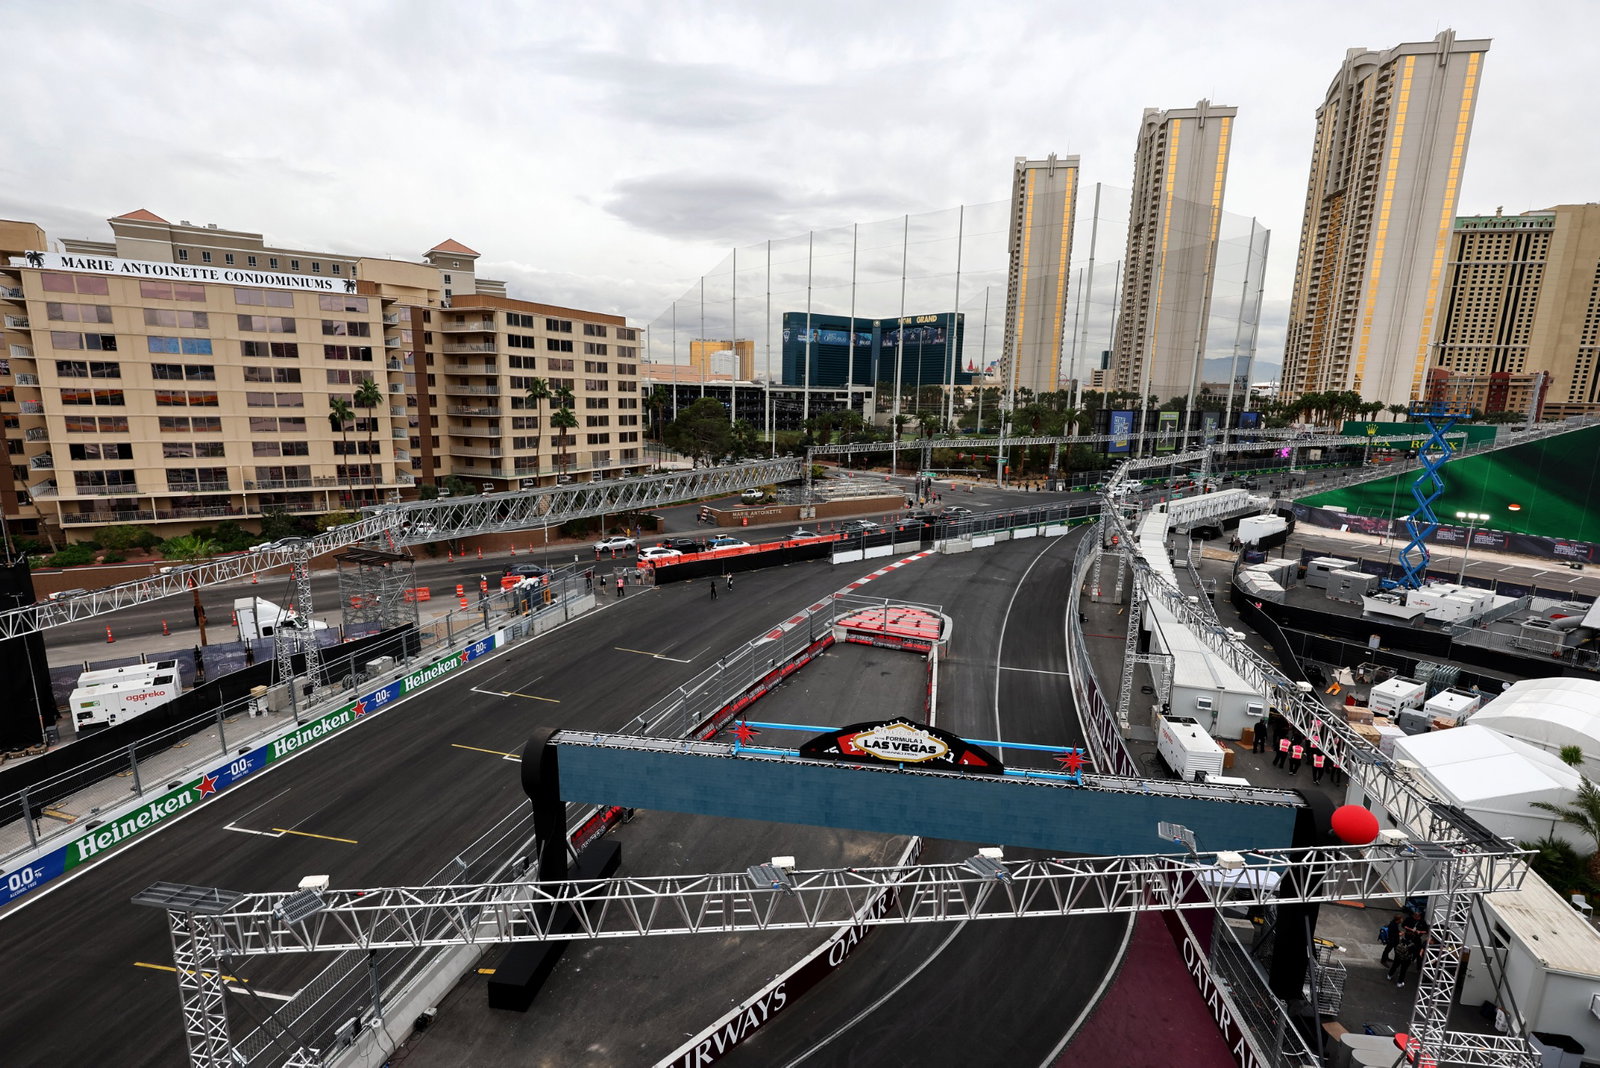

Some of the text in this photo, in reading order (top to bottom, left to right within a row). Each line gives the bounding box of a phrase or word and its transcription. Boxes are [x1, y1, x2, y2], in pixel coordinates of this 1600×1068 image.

[61, 256, 333, 290] MARIE ANTOINETTE CONDOMINIUMS
[916, 315, 938, 324] GRAND
[1411, 440, 1458, 450] ROLX
[404, 657, 458, 692] Heineken
[126, 690, 166, 702] aggreko
[273, 711, 350, 759] Heineken
[863, 739, 890, 750] LAS
[892, 742, 937, 754] VEGAS
[885, 735, 919, 743] FORMULA
[76, 790, 192, 861] Heineken
[1183, 936, 1232, 1042] QATAR
[665, 982, 787, 1068] IRWAYS
